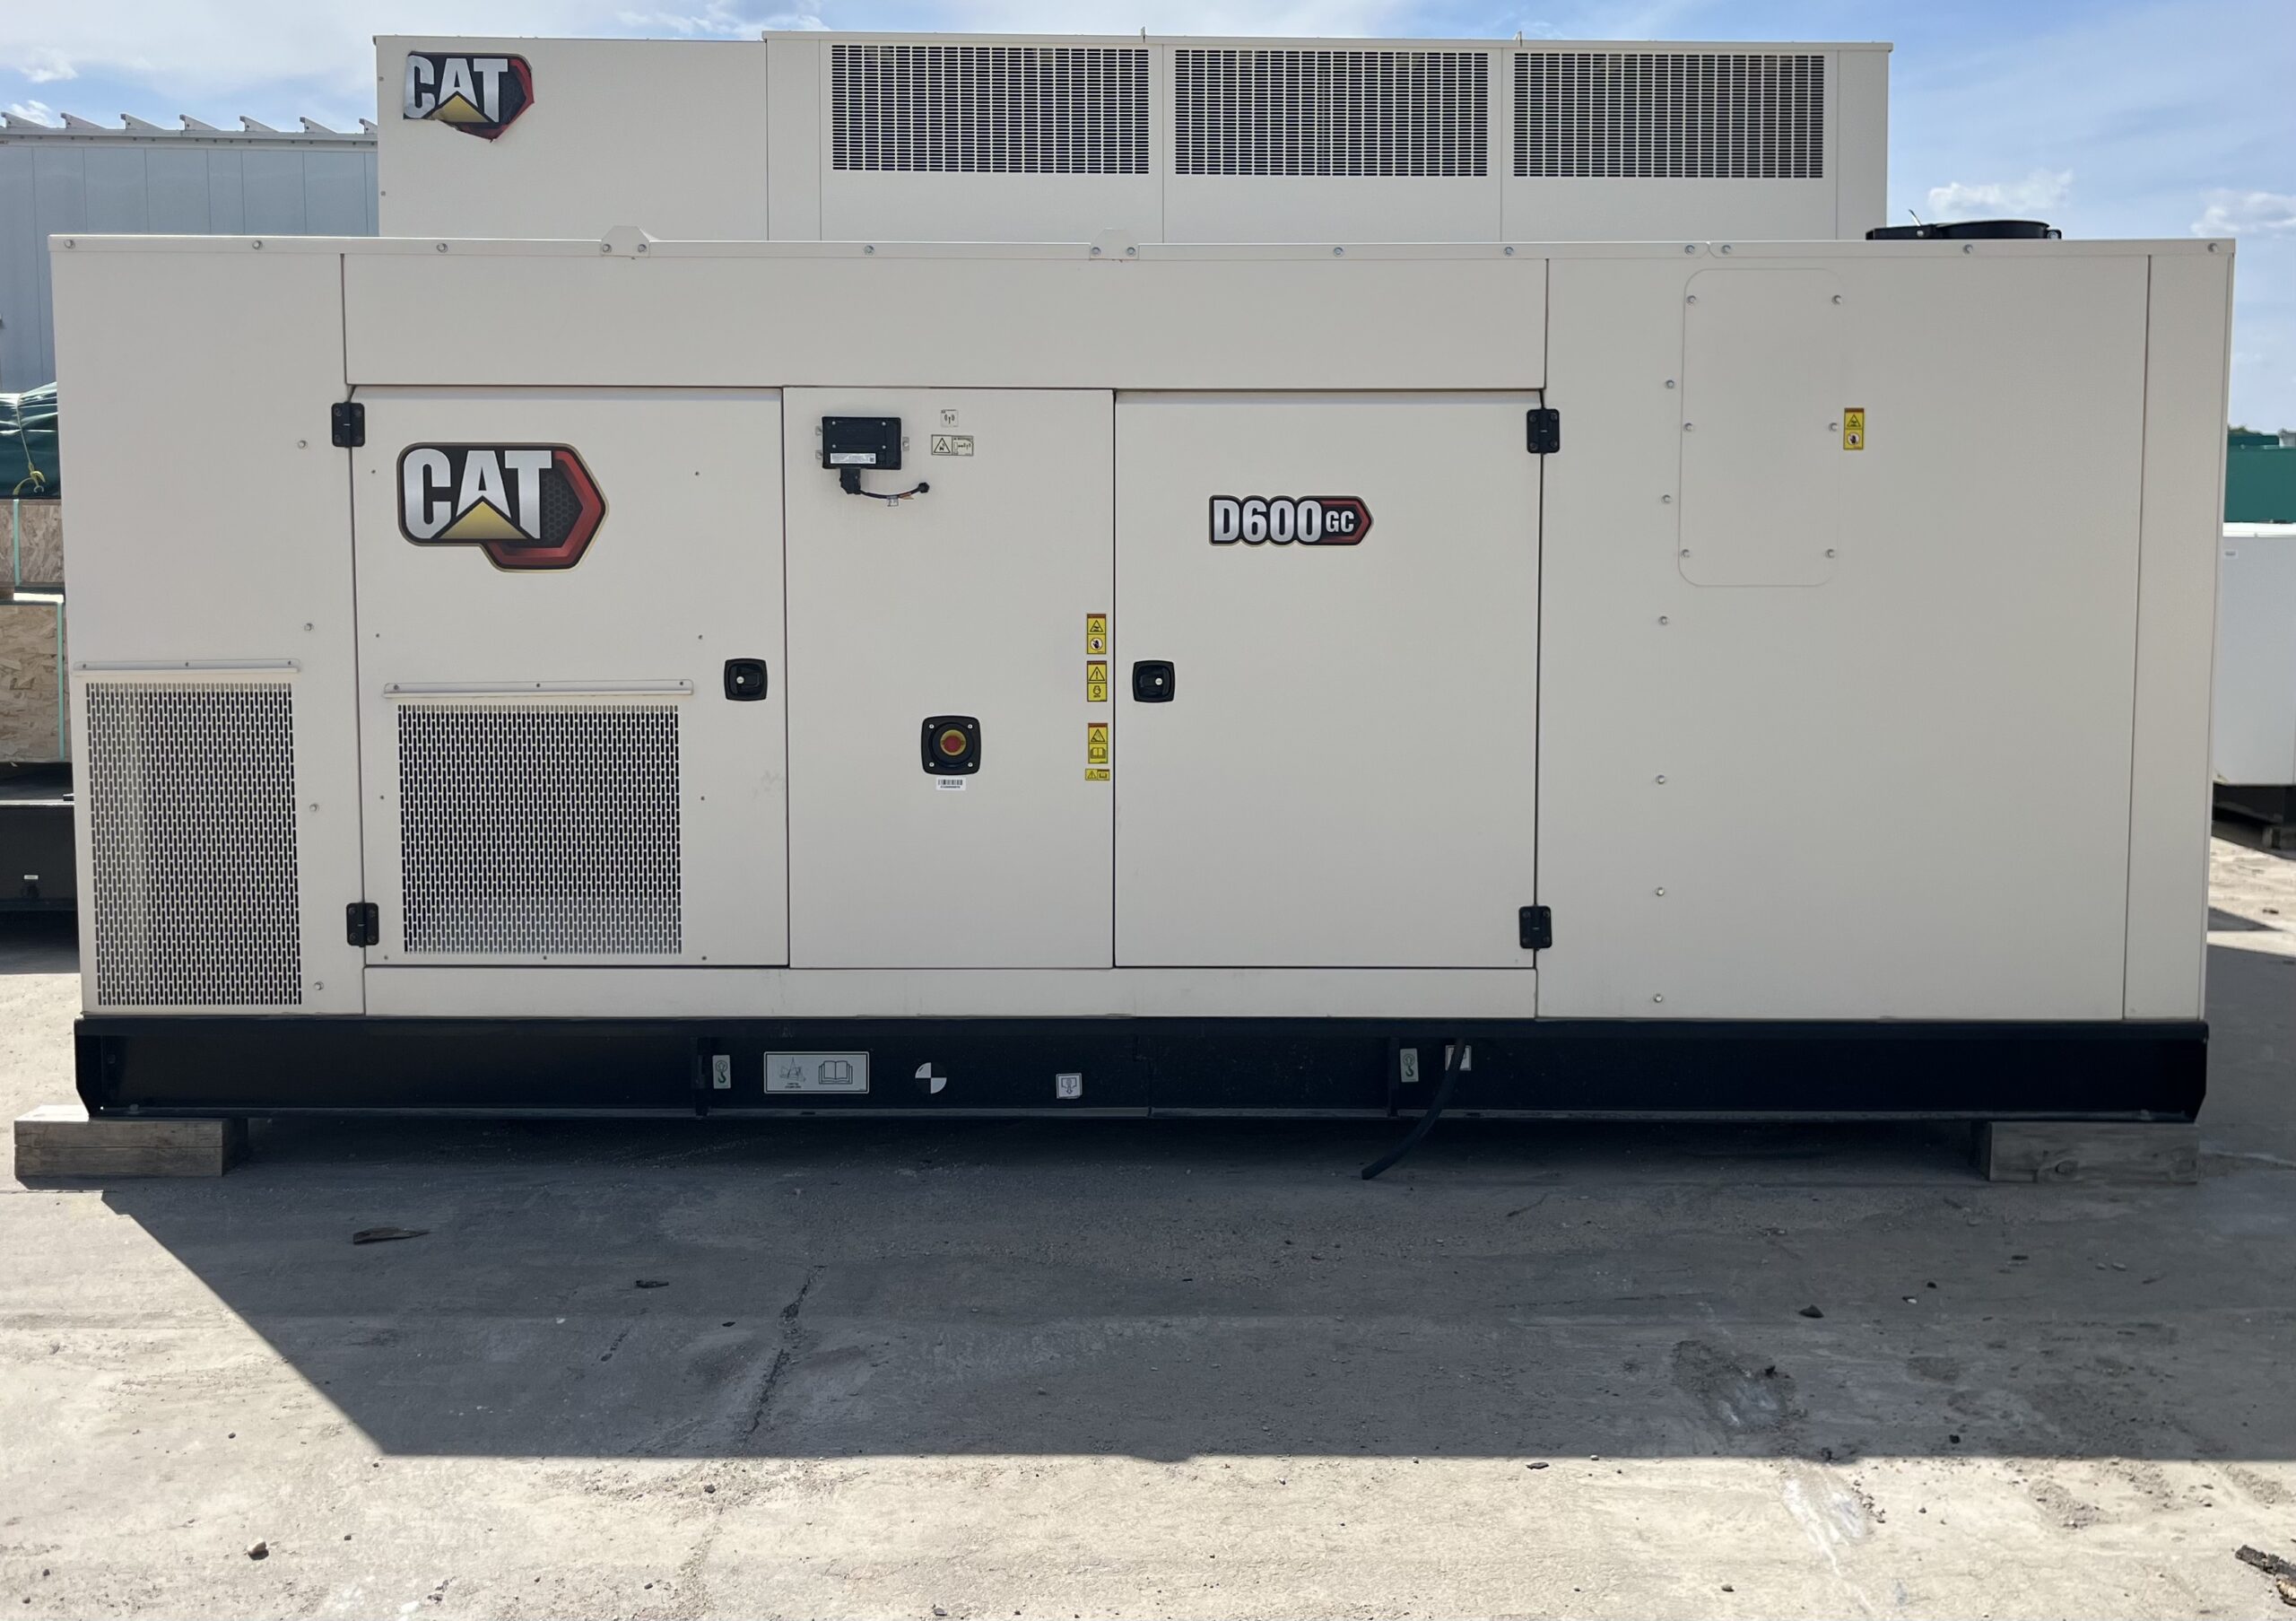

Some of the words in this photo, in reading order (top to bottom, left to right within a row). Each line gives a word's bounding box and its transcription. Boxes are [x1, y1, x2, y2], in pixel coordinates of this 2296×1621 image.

[404, 55, 509, 123] CAT
[404, 448, 552, 539] CAT
[1213, 499, 1323, 543] D600
[1326, 510, 1354, 533] GC
